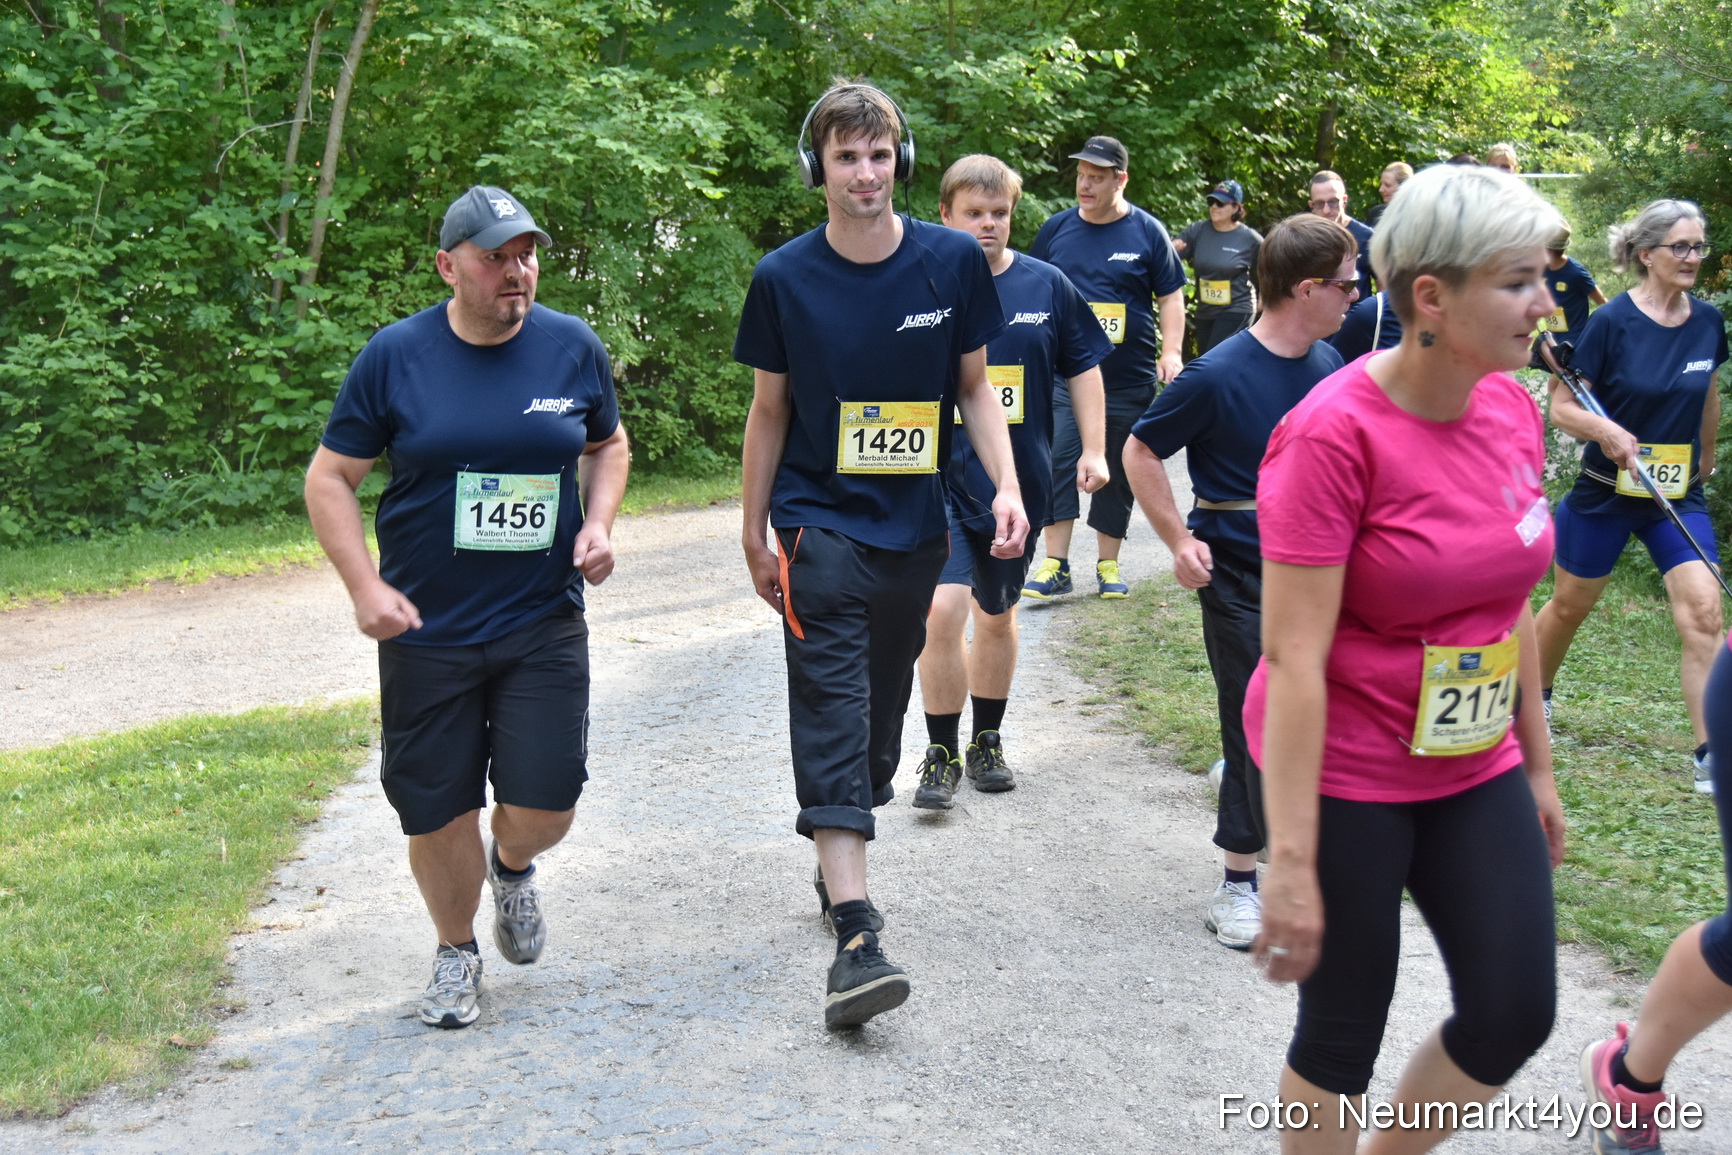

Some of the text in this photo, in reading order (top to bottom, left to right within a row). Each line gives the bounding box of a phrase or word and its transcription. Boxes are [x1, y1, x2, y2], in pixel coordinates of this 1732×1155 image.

[1205, 289, 1222, 298] 182
[896, 312, 937, 332] JURA
[1009, 312, 1039, 325] JURA
[1099, 318, 1118, 332] 35
[1682, 360, 1708, 373] JURA
[523, 398, 561, 414] JURA
[855, 416, 895, 425] firmenlauf
[852, 428, 925, 454] 1420
[473, 488, 515, 498] firmenlauf
[470, 501, 546, 529] 1456
[1434, 673, 1511, 725] 2174
